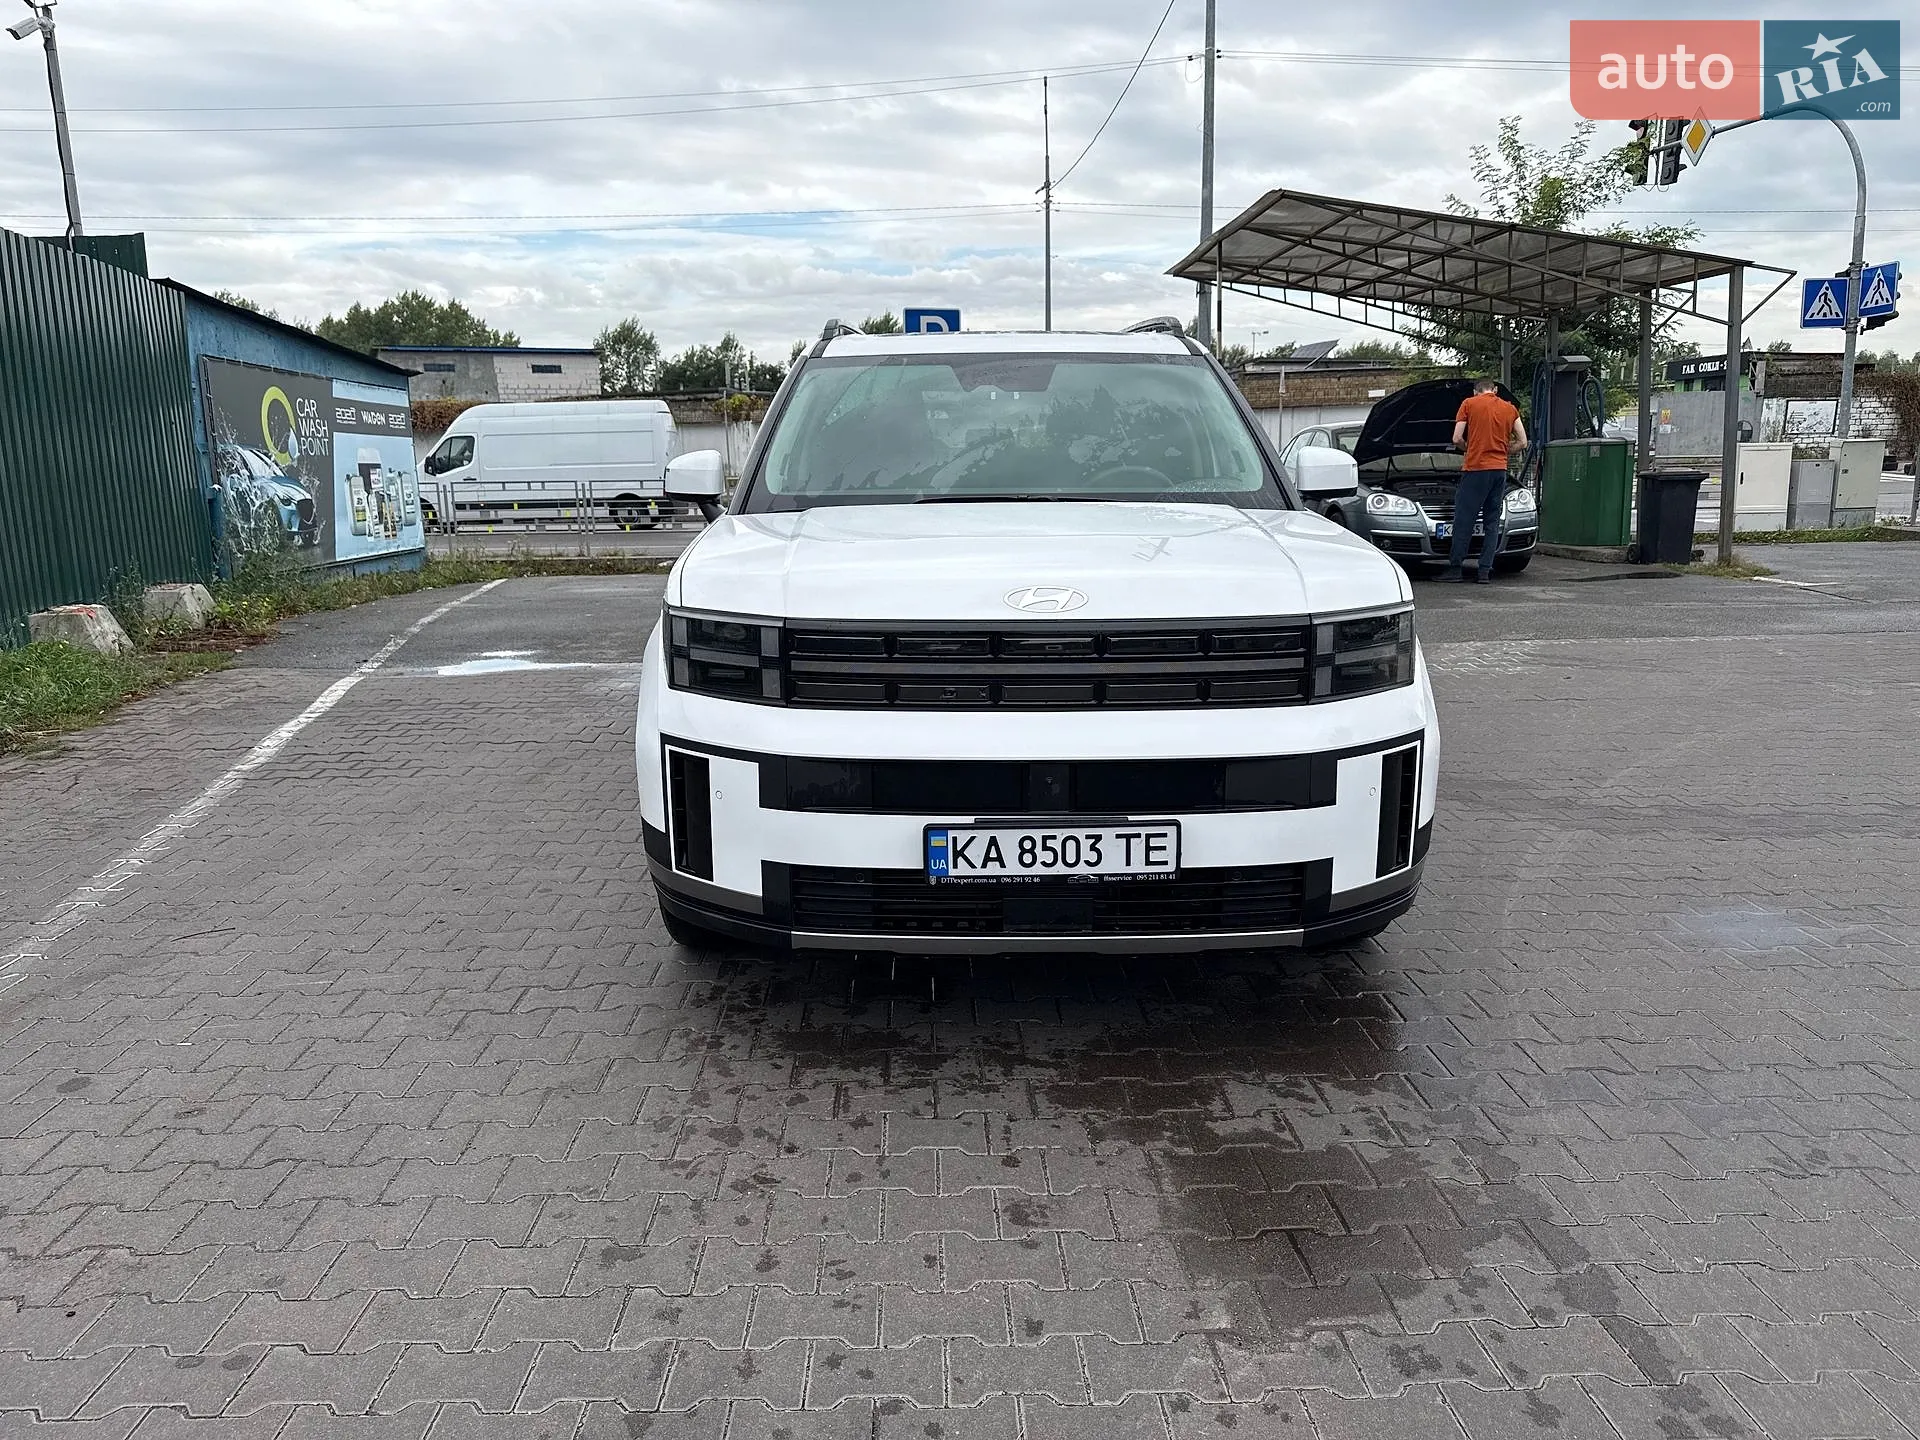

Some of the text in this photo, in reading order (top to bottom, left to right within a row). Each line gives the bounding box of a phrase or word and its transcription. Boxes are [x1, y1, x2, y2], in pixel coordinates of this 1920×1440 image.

[296, 398, 318, 418] CAR
[299, 418, 329, 438] WASH
[300, 437, 329, 456] POINT
[951, 832, 1169, 869] KA 8503 TE
[931, 859, 947, 870] UA
